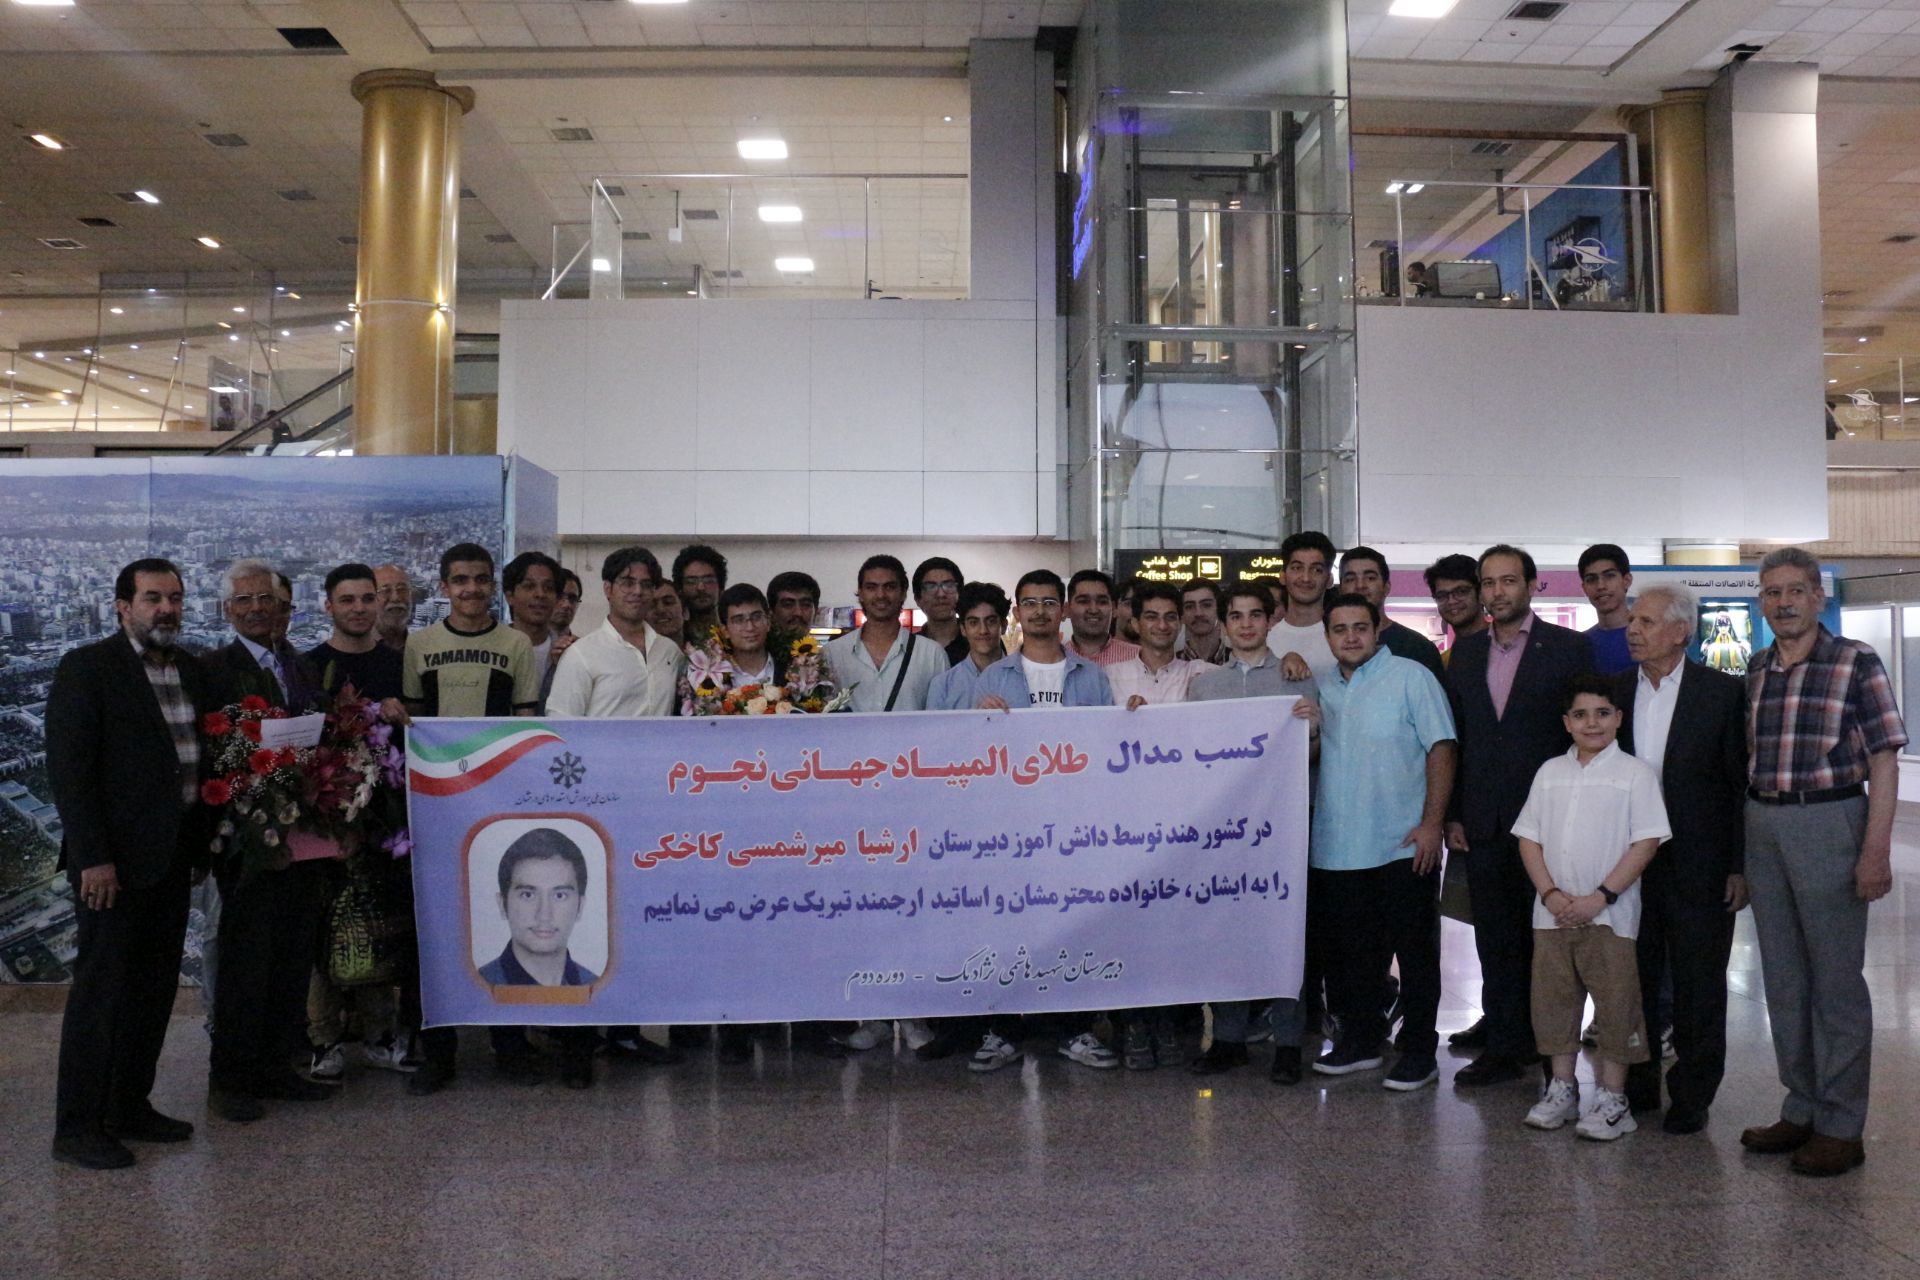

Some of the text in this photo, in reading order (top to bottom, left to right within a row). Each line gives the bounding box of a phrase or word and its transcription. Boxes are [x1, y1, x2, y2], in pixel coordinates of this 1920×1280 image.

[1142, 556, 1192, 568] کافی شاپ
[1169, 570, 1193, 581] Shop
[424, 649, 508, 669] YAMAMOTO
[668, 733, 1269, 795] کسب مدال طلای المپیاد جهانی نجوم
[857, 827, 918, 863] ارشیا
[928, 829, 1009, 860] دبیرستان
[1012, 823, 1055, 858] آموز
[1059, 824, 1108, 856] دانش
[1112, 823, 1162, 852] توسط
[1166, 824, 1199, 844] هند
[1202, 817, 1248, 849] کشور
[1251, 820, 1272, 847] در
[633, 831, 725, 869] کاخکی
[931, 885, 990, 915] اساتید
[1109, 878, 1181, 908] خانواده
[1250, 877, 1269, 900] به
[1272, 870, 1290, 900] را
[644, 892, 700, 923] نماییم
[704, 900, 735, 921] می
[739, 894, 790, 921] عرض
[793, 889, 851, 920] تبریک
[856, 887, 924, 917] ارجمند
[994, 894, 1005, 915] و
[875, 971, 904, 985] دوره
[999, 945, 1032, 986] هاشمی
[1031, 949, 1068, 992] شهید
[1064, 951, 1124, 983] دبیرستان
[846, 971, 874, 1000] دوم
